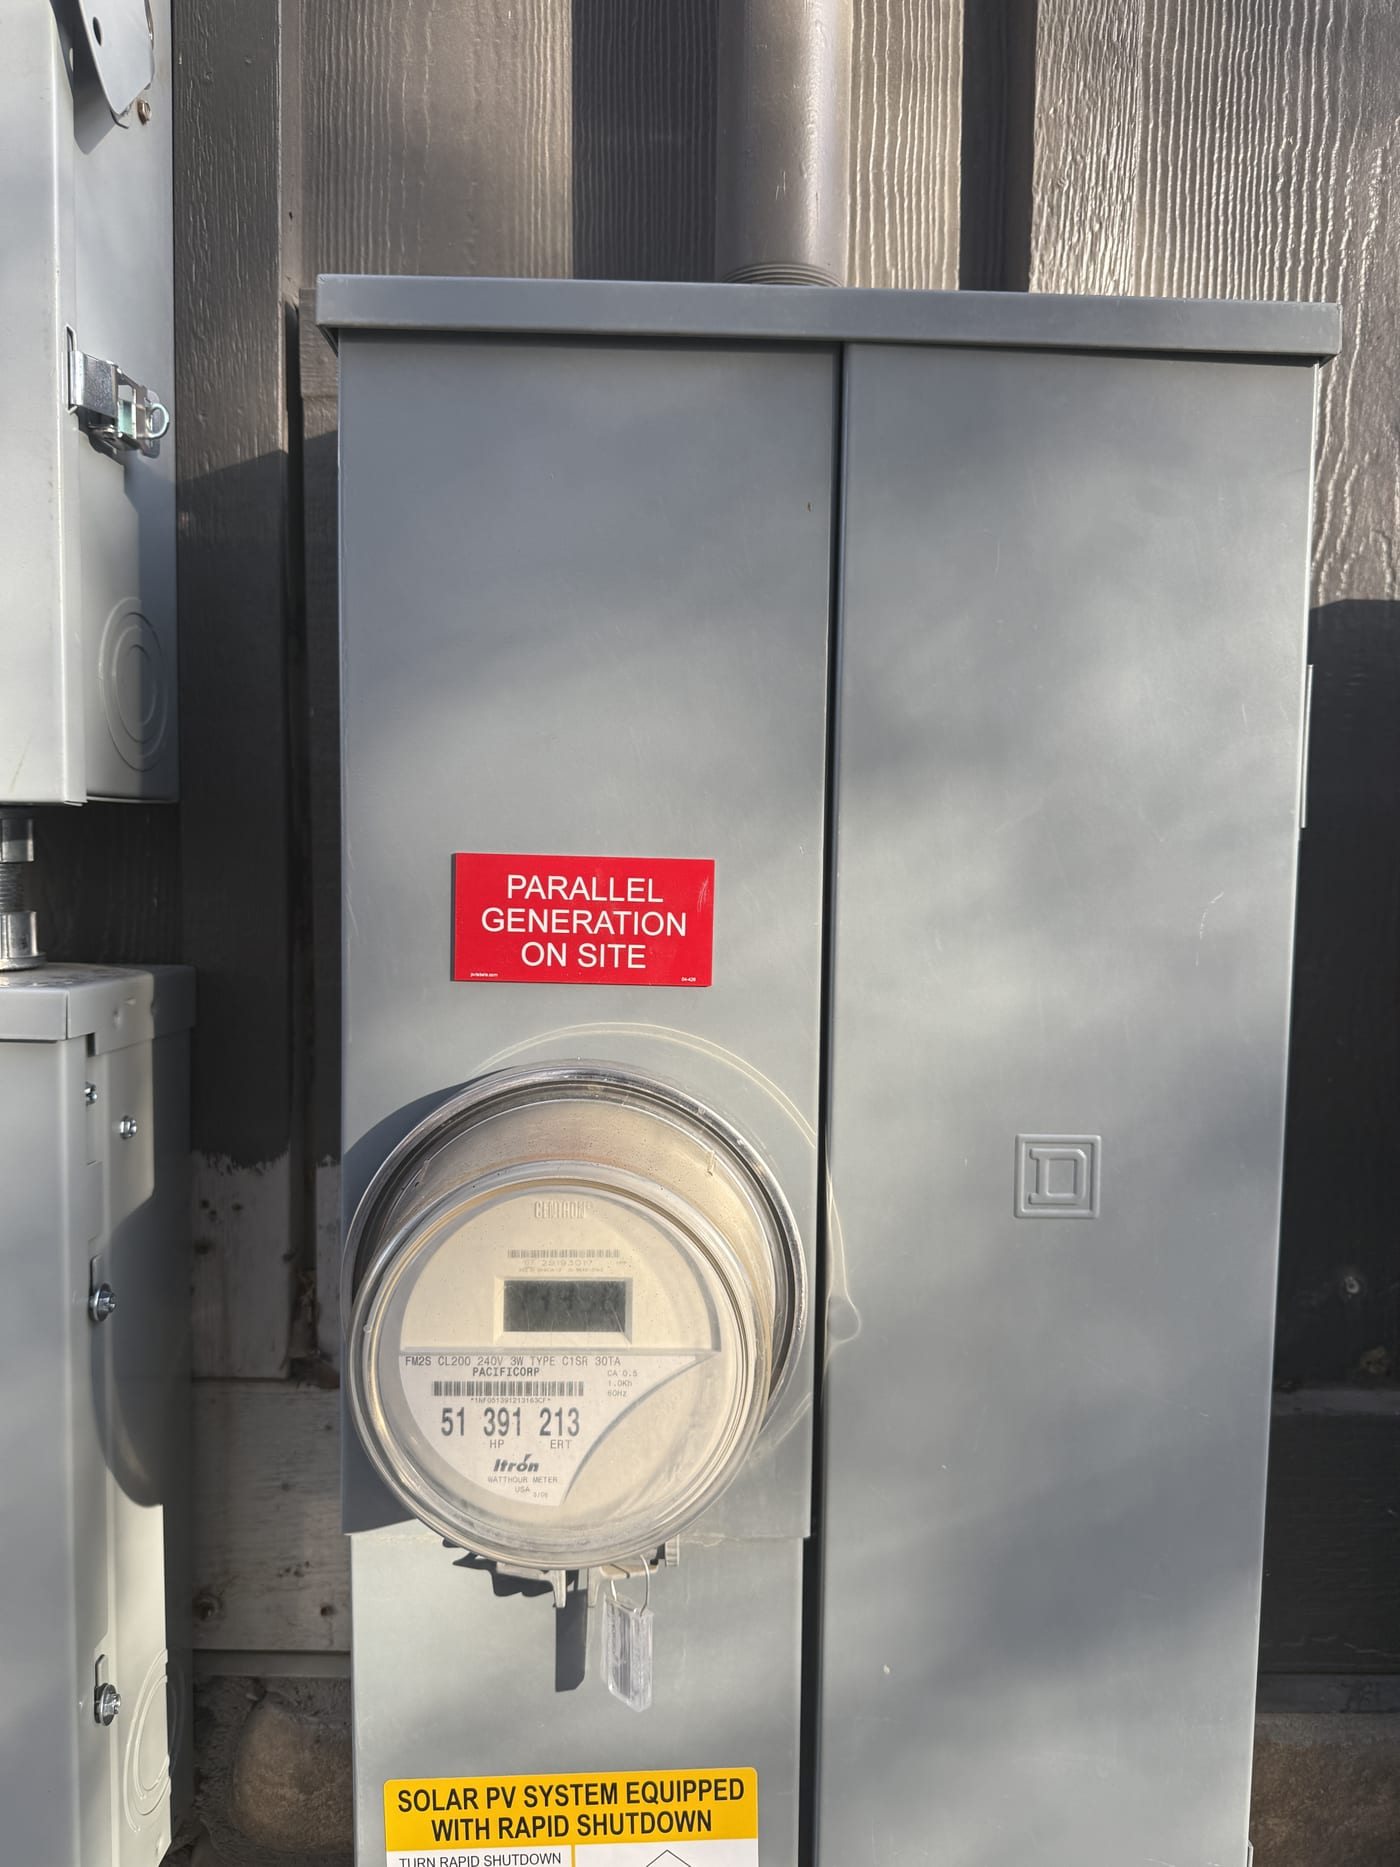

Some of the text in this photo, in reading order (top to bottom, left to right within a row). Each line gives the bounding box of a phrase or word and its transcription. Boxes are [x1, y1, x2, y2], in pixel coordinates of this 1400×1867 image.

[507, 874, 664, 902] PARALLEL
[481, 907, 687, 936] GENERATION
[521, 941, 646, 968] ON SITE
[405, 1356, 432, 1366] FM2S
[437, 1356, 471, 1366] CL200
[477, 1356, 504, 1366] 240V
[510, 1356, 524, 1366] 3W
[531, 1356, 556, 1366] TYPE
[595, 1356, 621, 1366] 30TA
[472, 1367, 540, 1377] PACIFICORP
[607, 1369, 638, 1377] CA 0.5
[607, 1379, 633, 1387] 1.0Kh
[441, 1407, 580, 1437] 51 391 213
[489, 1440, 572, 1449] HP ERT
[488, 1476, 558, 1484] WATTHOUR METER
[398, 1777, 745, 1813] SOLAR PV SYSTEM EQUIPPED
[431, 1809, 712, 1842] WITH RAPID SHUTDOWN
[399, 1852, 562, 1867] TURN RAPID SHUTDOWN
